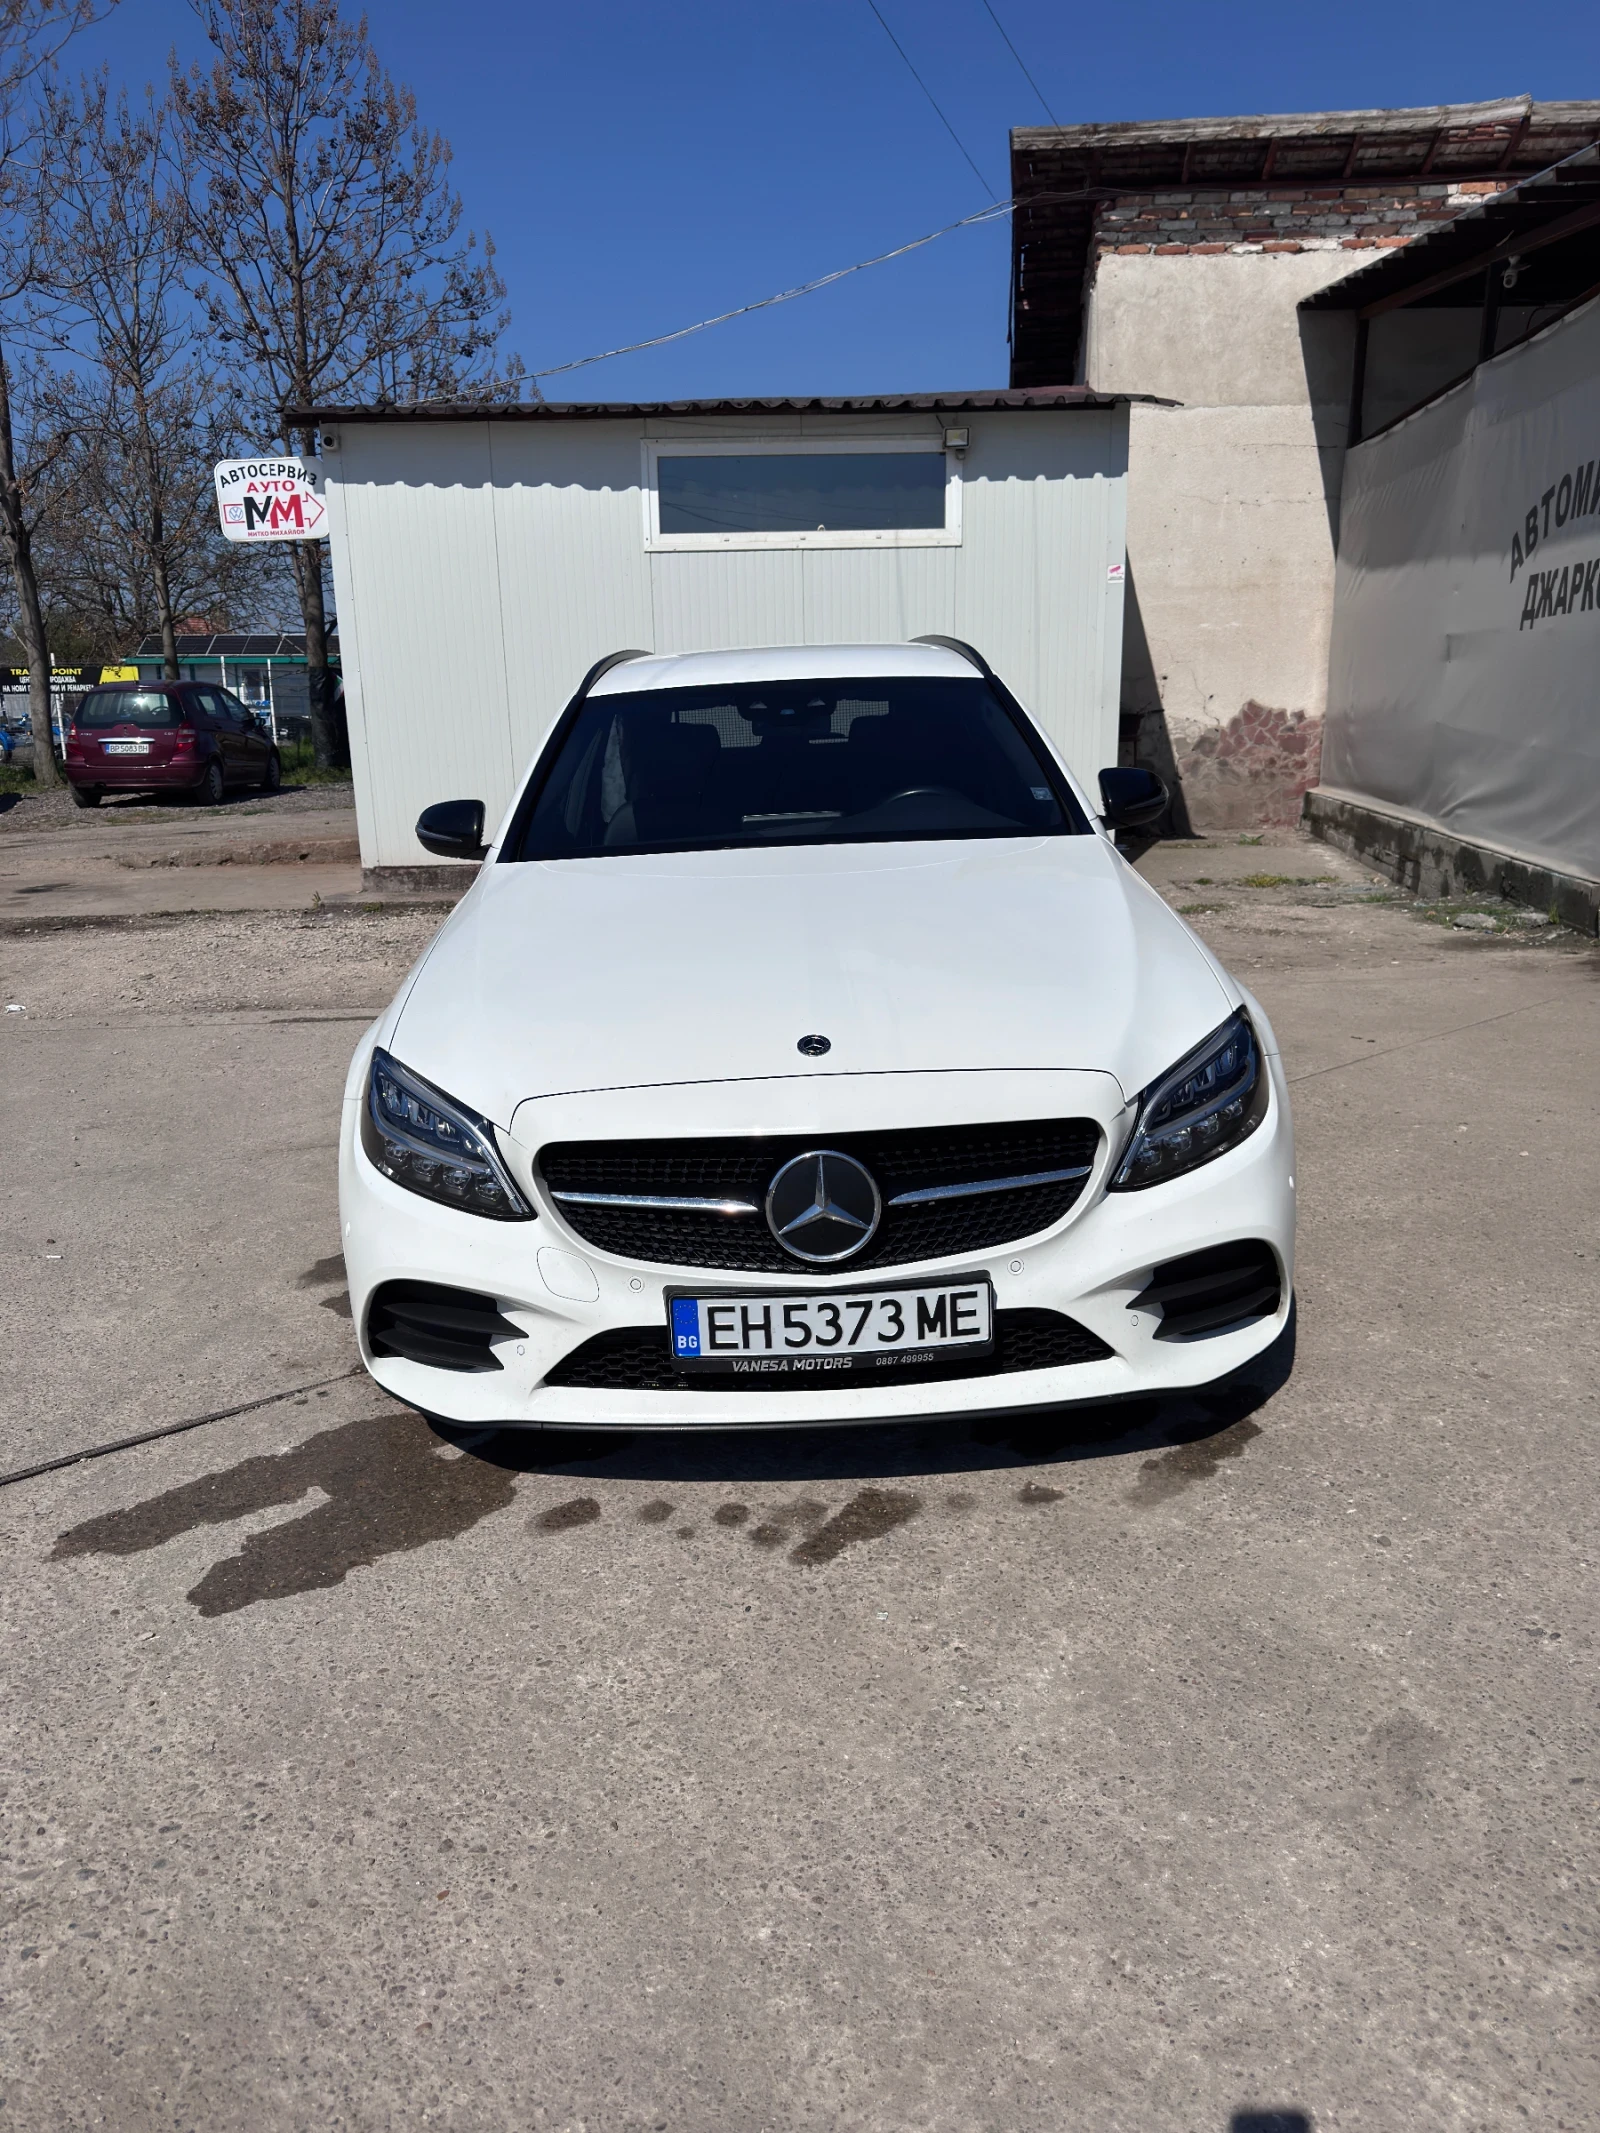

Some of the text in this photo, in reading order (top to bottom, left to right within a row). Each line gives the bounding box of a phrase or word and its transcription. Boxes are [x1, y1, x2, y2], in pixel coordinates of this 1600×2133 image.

[220, 463, 318, 488] АВТОСЕРВИЗ
[247, 480, 296, 493] АУТО
[782, 1299, 905, 1348] 5373
[677, 1335, 698, 1349] BG
[732, 1352, 935, 1373] VANESA MOTORS 0887 499955
